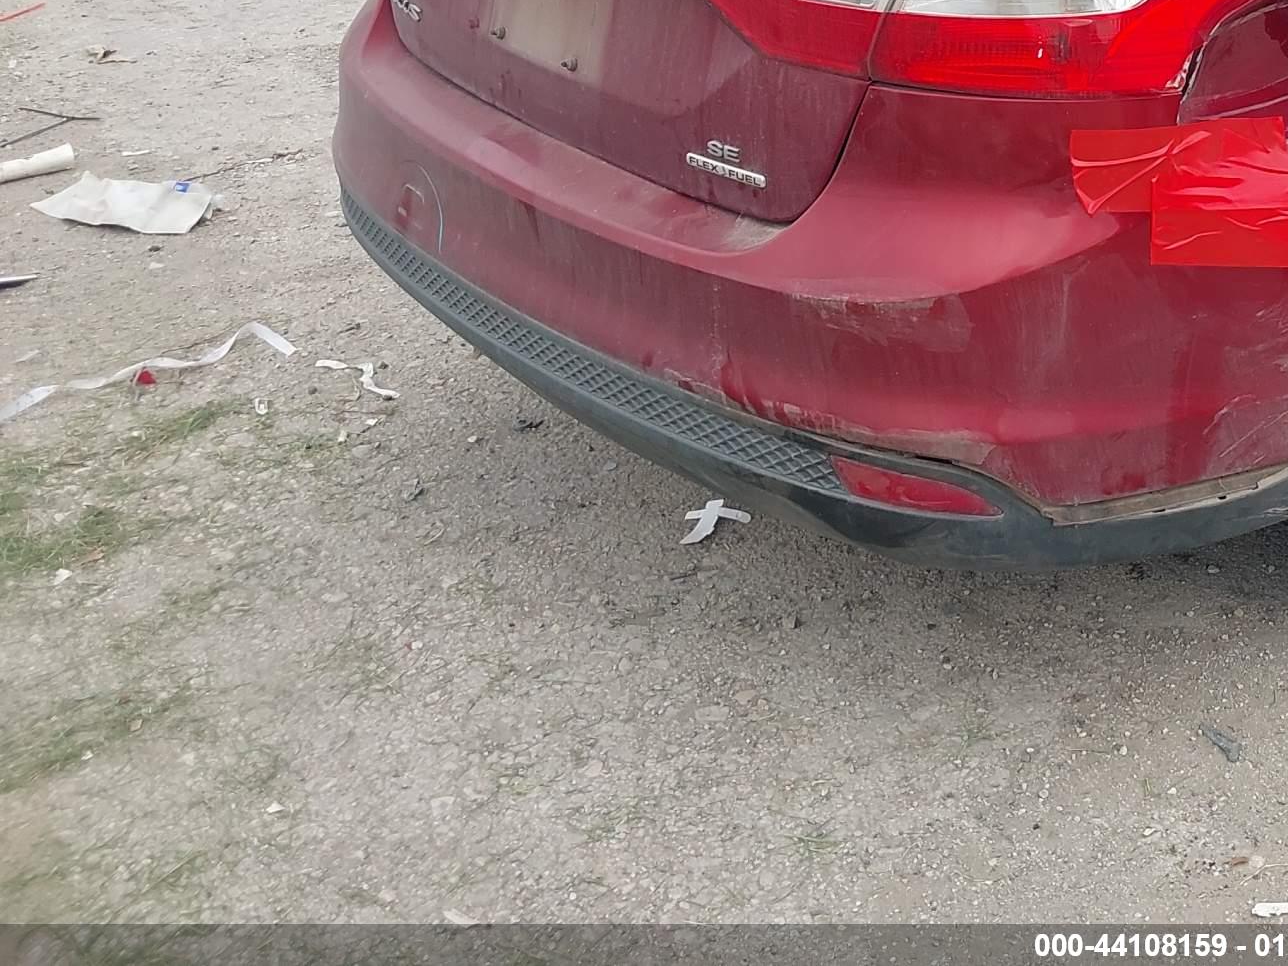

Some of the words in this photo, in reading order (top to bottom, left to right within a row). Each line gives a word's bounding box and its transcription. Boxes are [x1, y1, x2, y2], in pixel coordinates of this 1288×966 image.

[706, 140, 740, 163] SE
[689, 156, 719, 174] FLEX
[728, 169, 761, 186] FUEL
